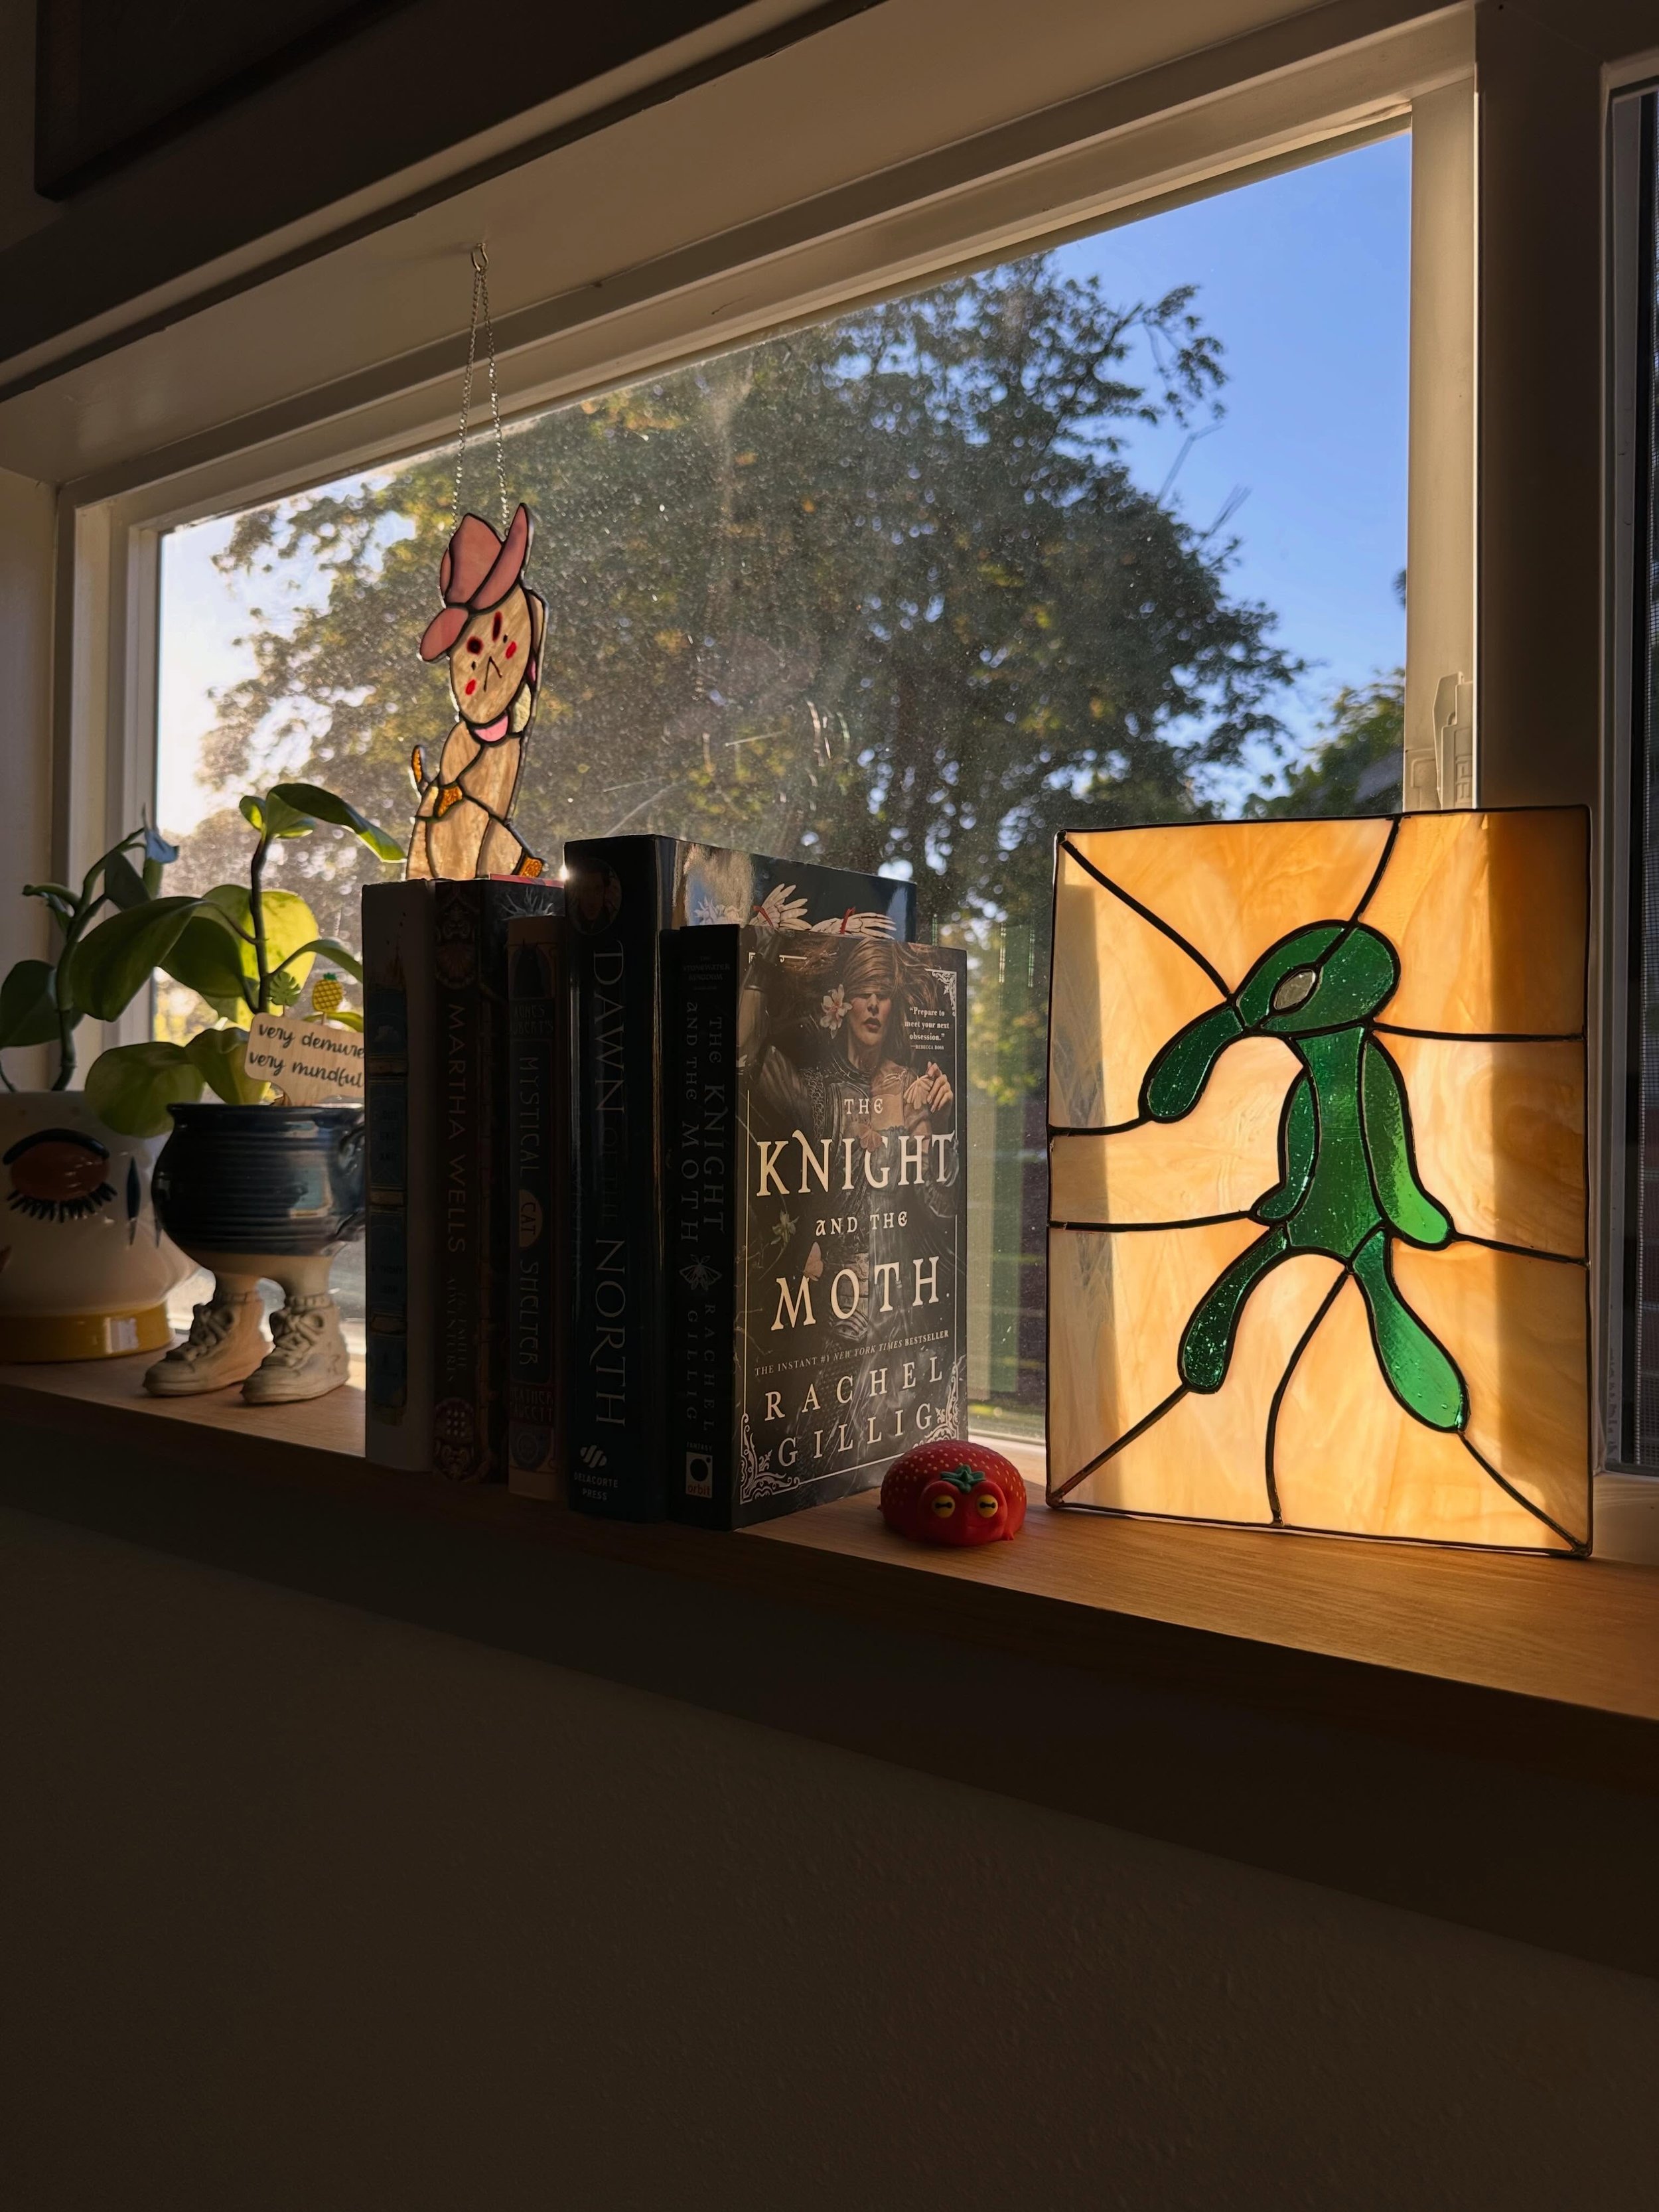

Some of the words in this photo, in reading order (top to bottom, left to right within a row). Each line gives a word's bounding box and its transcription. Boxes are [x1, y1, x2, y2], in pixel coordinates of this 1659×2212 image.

[258, 1024, 295, 1049] very
[301, 1032, 364, 1059] demure
[593, 938, 626, 1114] DAWN
[708, 1016, 723, 1063] THE
[249, 1051, 286, 1076] very
[292, 1062, 364, 1088] mindful
[447, 1002, 467, 1141] MARTHA
[685, 1056, 699, 1100] THE
[519, 1056, 540, 1179] MYSTICAL
[844, 1098, 884, 1115] THE
[680, 1120, 701, 1243] MOTH
[703, 1083, 729, 1236] KNIGHT
[756, 1129, 956, 1197] KNIGHT
[446, 1153, 467, 1253] WELLS
[520, 1201, 536, 1235] CAT
[815, 1216, 858, 1237] AND
[871, 1211, 908, 1229] THE
[520, 1260, 539, 1366] SHELTER
[770, 1256, 940, 1331] MOTH
[589, 1237, 627, 1428] NORTH
[754, 1365, 774, 1376] THE
[777, 1356, 817, 1372] INSTANT
[833, 1349, 853, 1361] NEW
[854, 1343, 877, 1359] YORK
[878, 1339, 903, 1353] TIMES
[904, 1329, 950, 1347] BESTSELLER
[686, 1310, 699, 1421] GILLIG
[703, 1303, 716, 1432] RACHEL
[764, 1357, 943, 1422] RACHEL
[686, 1441, 713, 1453] FANTASY
[778, 1403, 932, 1467] GILLIG
[573, 1469, 619, 1489] DELACORTE
[582, 1487, 609, 1501] PRESS
[687, 1483, 711, 1496] orbit
